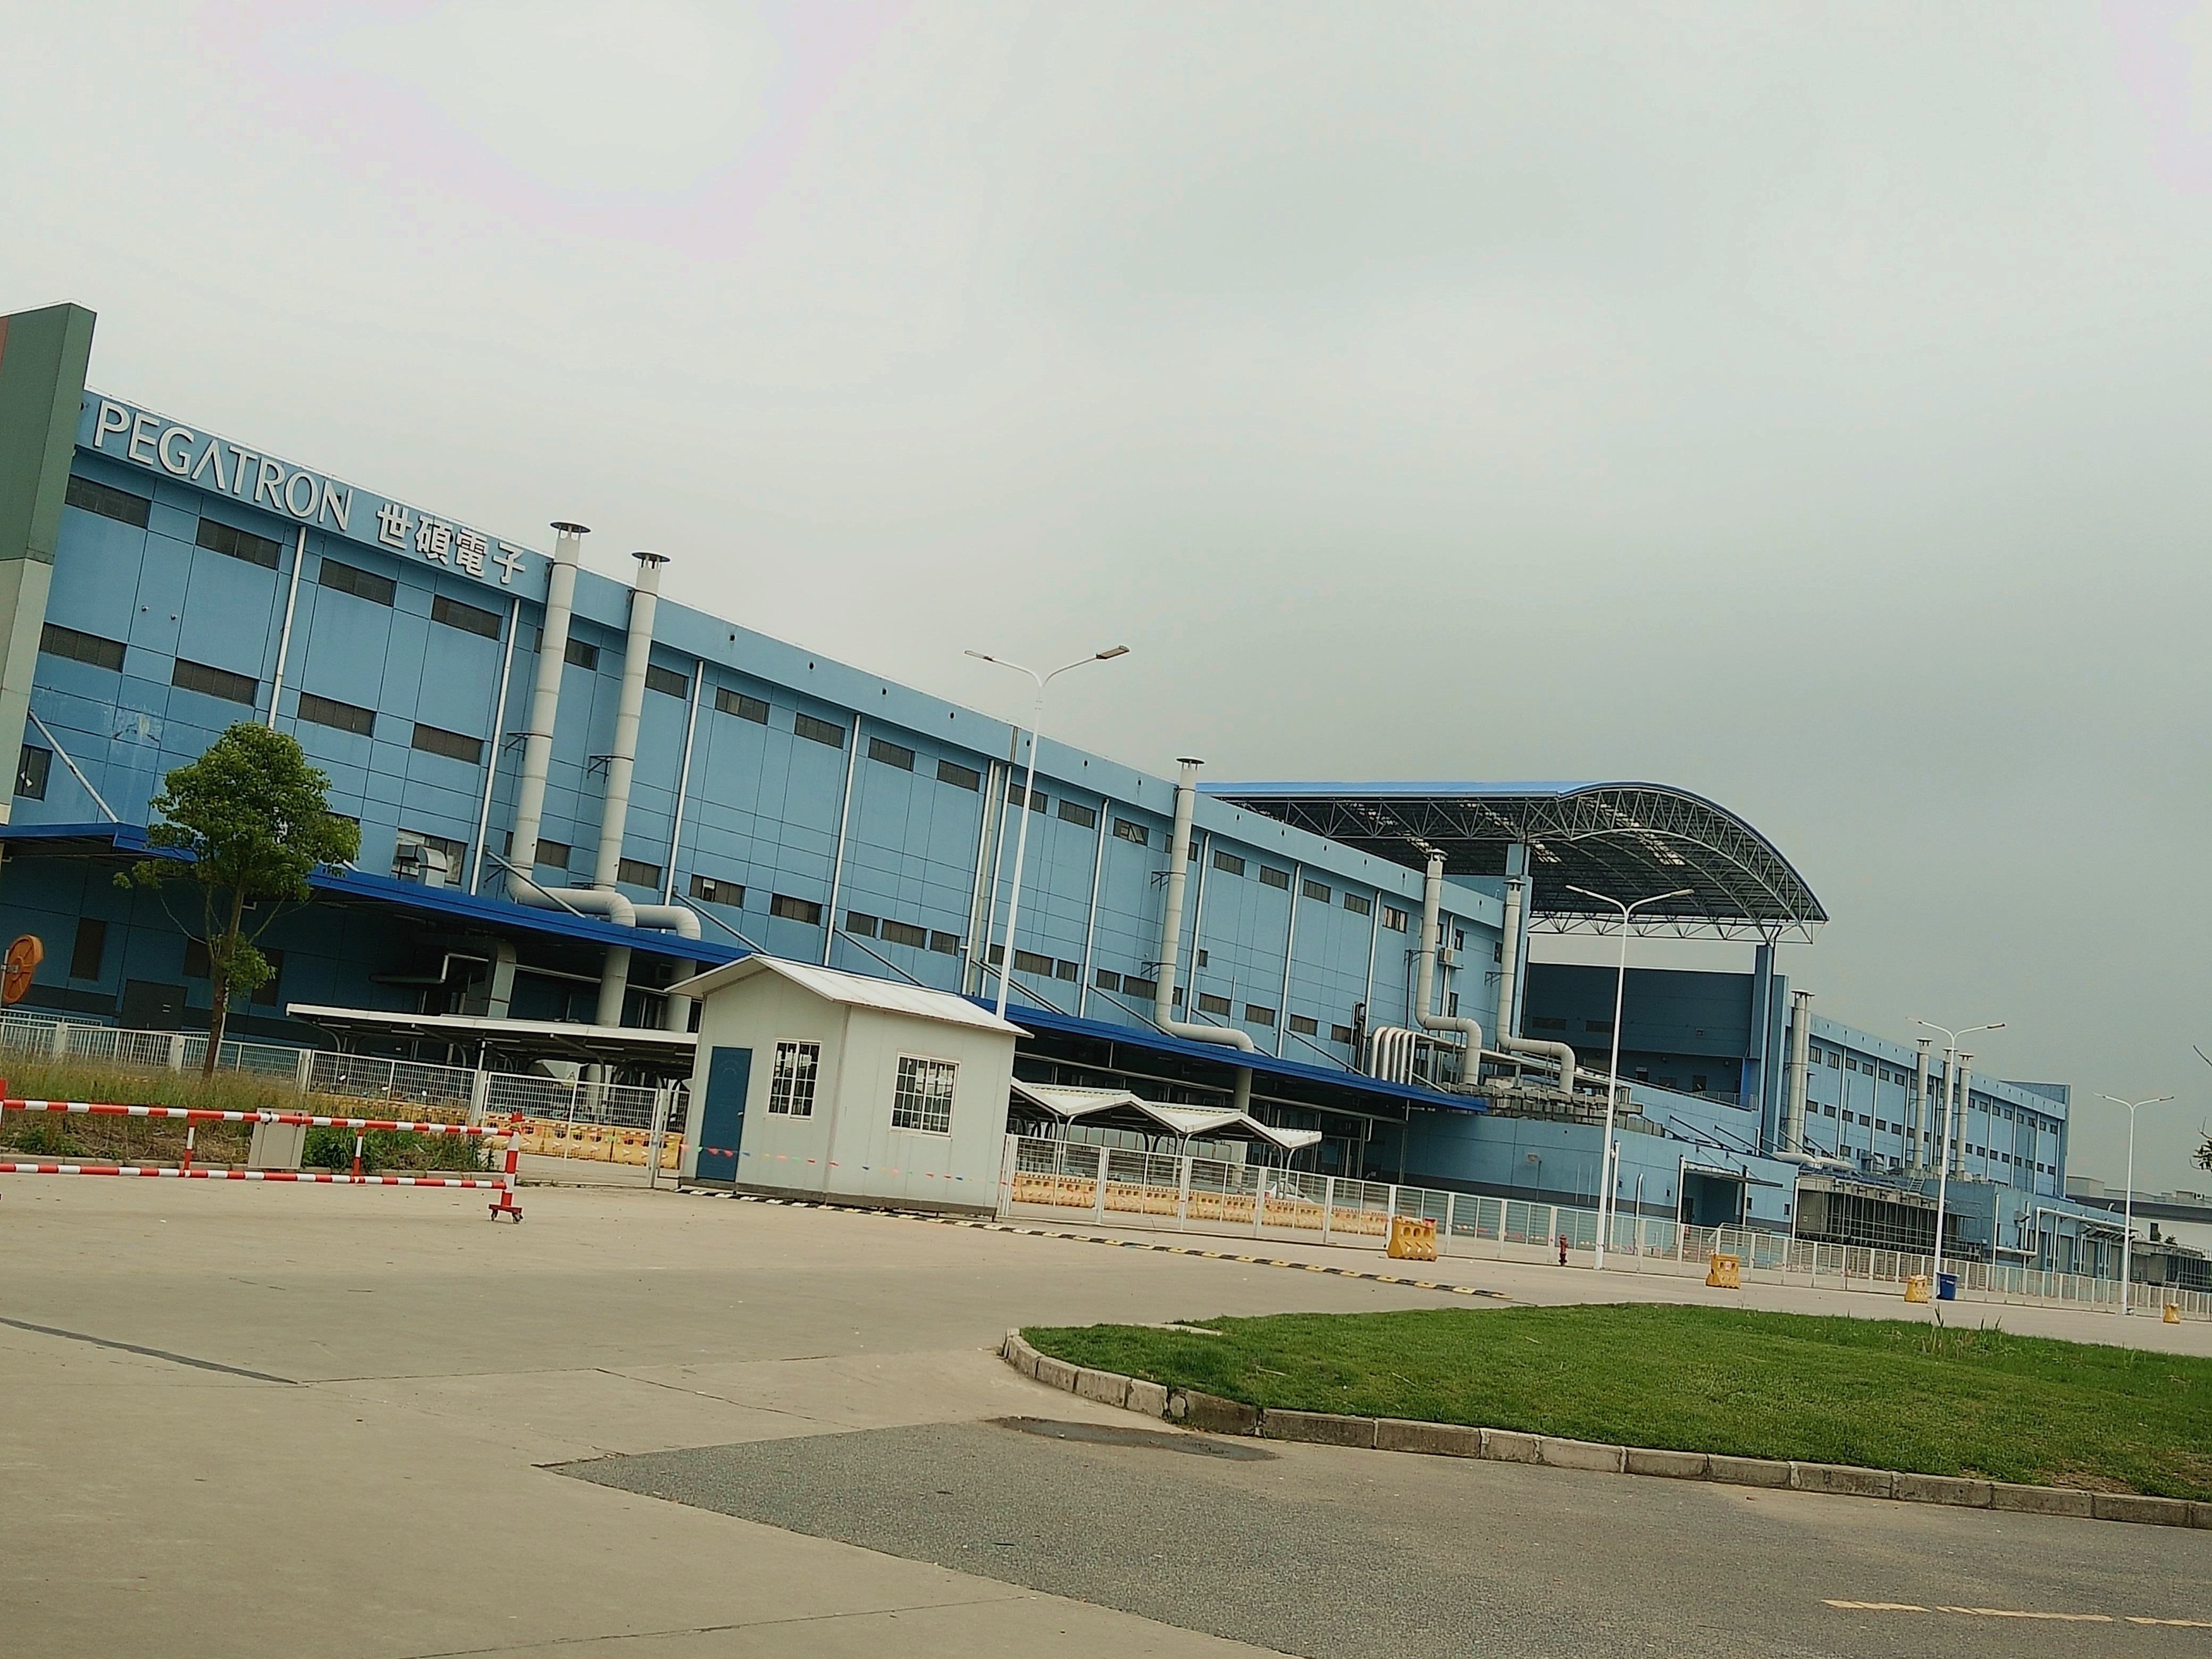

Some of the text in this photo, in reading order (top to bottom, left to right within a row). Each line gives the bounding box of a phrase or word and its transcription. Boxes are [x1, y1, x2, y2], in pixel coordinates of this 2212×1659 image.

[94, 400, 525, 584] PEGATRON 世碩電子
